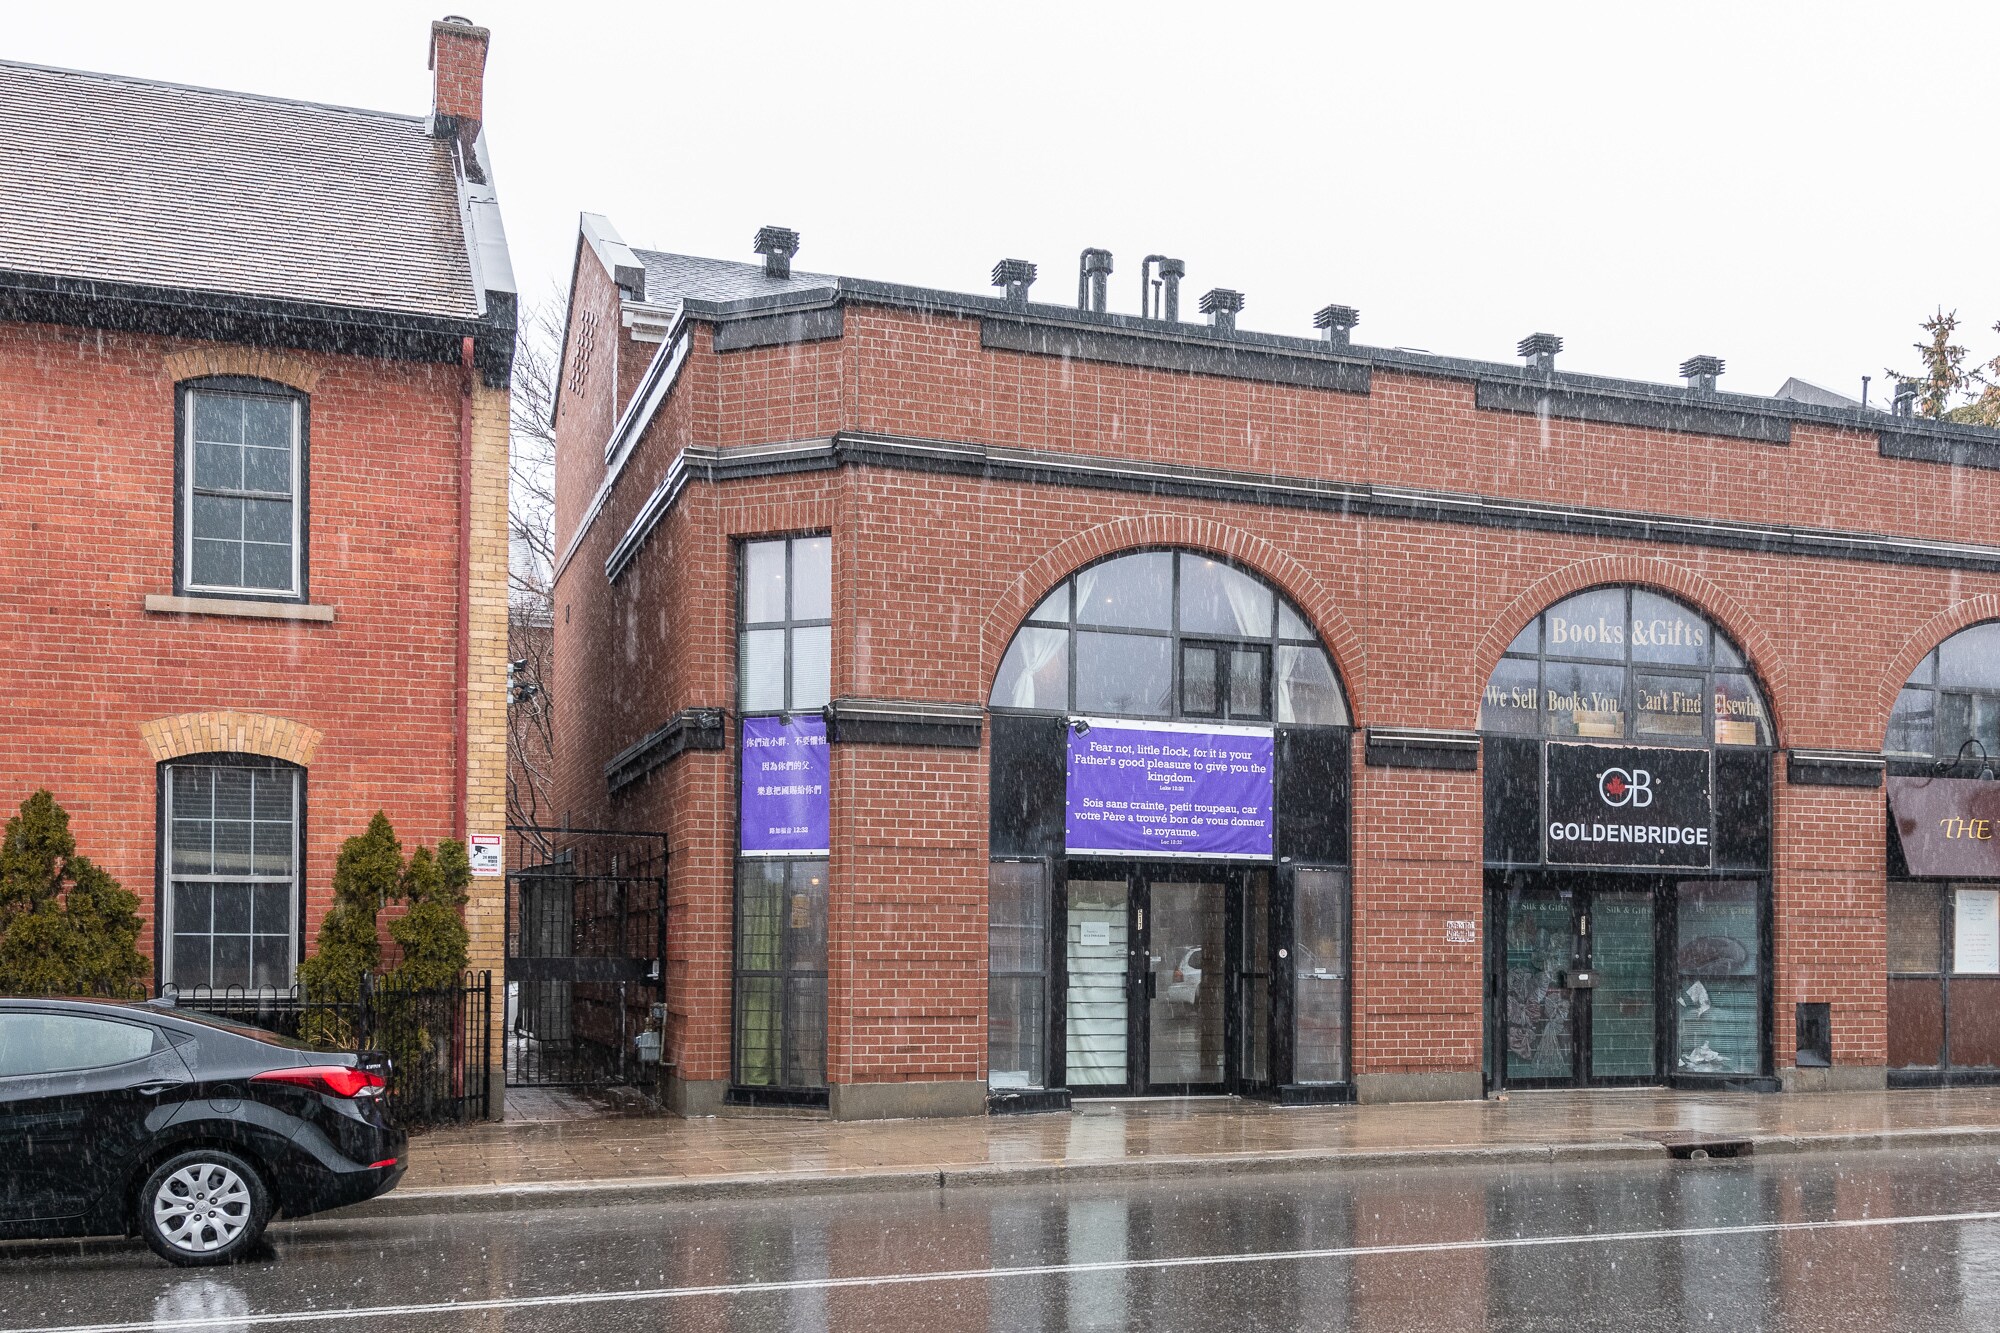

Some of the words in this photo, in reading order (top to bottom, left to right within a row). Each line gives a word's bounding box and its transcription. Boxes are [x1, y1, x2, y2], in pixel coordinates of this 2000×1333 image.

[1552, 617, 1624, 644] Books
[1485, 685, 1507, 708] We
[1512, 686, 1537, 709] Sell
[1548, 690, 1588, 711] Books
[1591, 691, 1618, 713] You
[1637, 689, 1668, 712] Can't
[1672, 691, 1702, 713] Find
[1089, 741, 1113, 752] Fear
[1115, 745, 1135, 755] not,
[1137, 744, 1160, 755] little
[1162, 745, 1191, 758] flock,
[1193, 747, 1208, 758] for
[1209, 748, 1217, 758] it
[1218, 748, 1227, 759] is
[1229, 750, 1252, 761] your
[1074, 754, 1116, 766] Father's
[1118, 757, 1146, 769] good
[1147, 758, 1191, 770] pleasure
[1194, 761, 1204, 770] to
[1205, 761, 1228, 773] give
[1230, 764, 1249, 775] you
[1250, 763, 1267, 773] the
[1147, 771, 1196, 784] kingdom.
[1599, 767, 1653, 808] GB
[1083, 797, 1104, 808] Sois
[1106, 800, 1128, 809] sans
[1130, 800, 1168, 812] crainte,
[1169, 802, 1192, 813] petit
[1194, 803, 1240, 815] troupeau,
[1242, 806, 1258, 814] car
[1074, 811, 1101, 821] votre
[1103, 811, 1126, 822] Père
[1127, 814, 1134, 822] a
[1136, 813, 1168, 823] trouvé
[1169, 814, 1189, 824] bon
[1190, 815, 1204, 825] de
[1205, 817, 1229, 826] vous
[1230, 816, 1266, 827] donner
[1940, 815, 1992, 840] THE
[1142, 825, 1153, 835] le
[1154, 828, 1200, 838] royaume.
[1549, 822, 1709, 845] GOLDENBRIDGE
[1548, 903, 1568, 912] Gifts
[1606, 905, 1621, 913] Silk
[1632, 906, 1651, 914] Gifts
